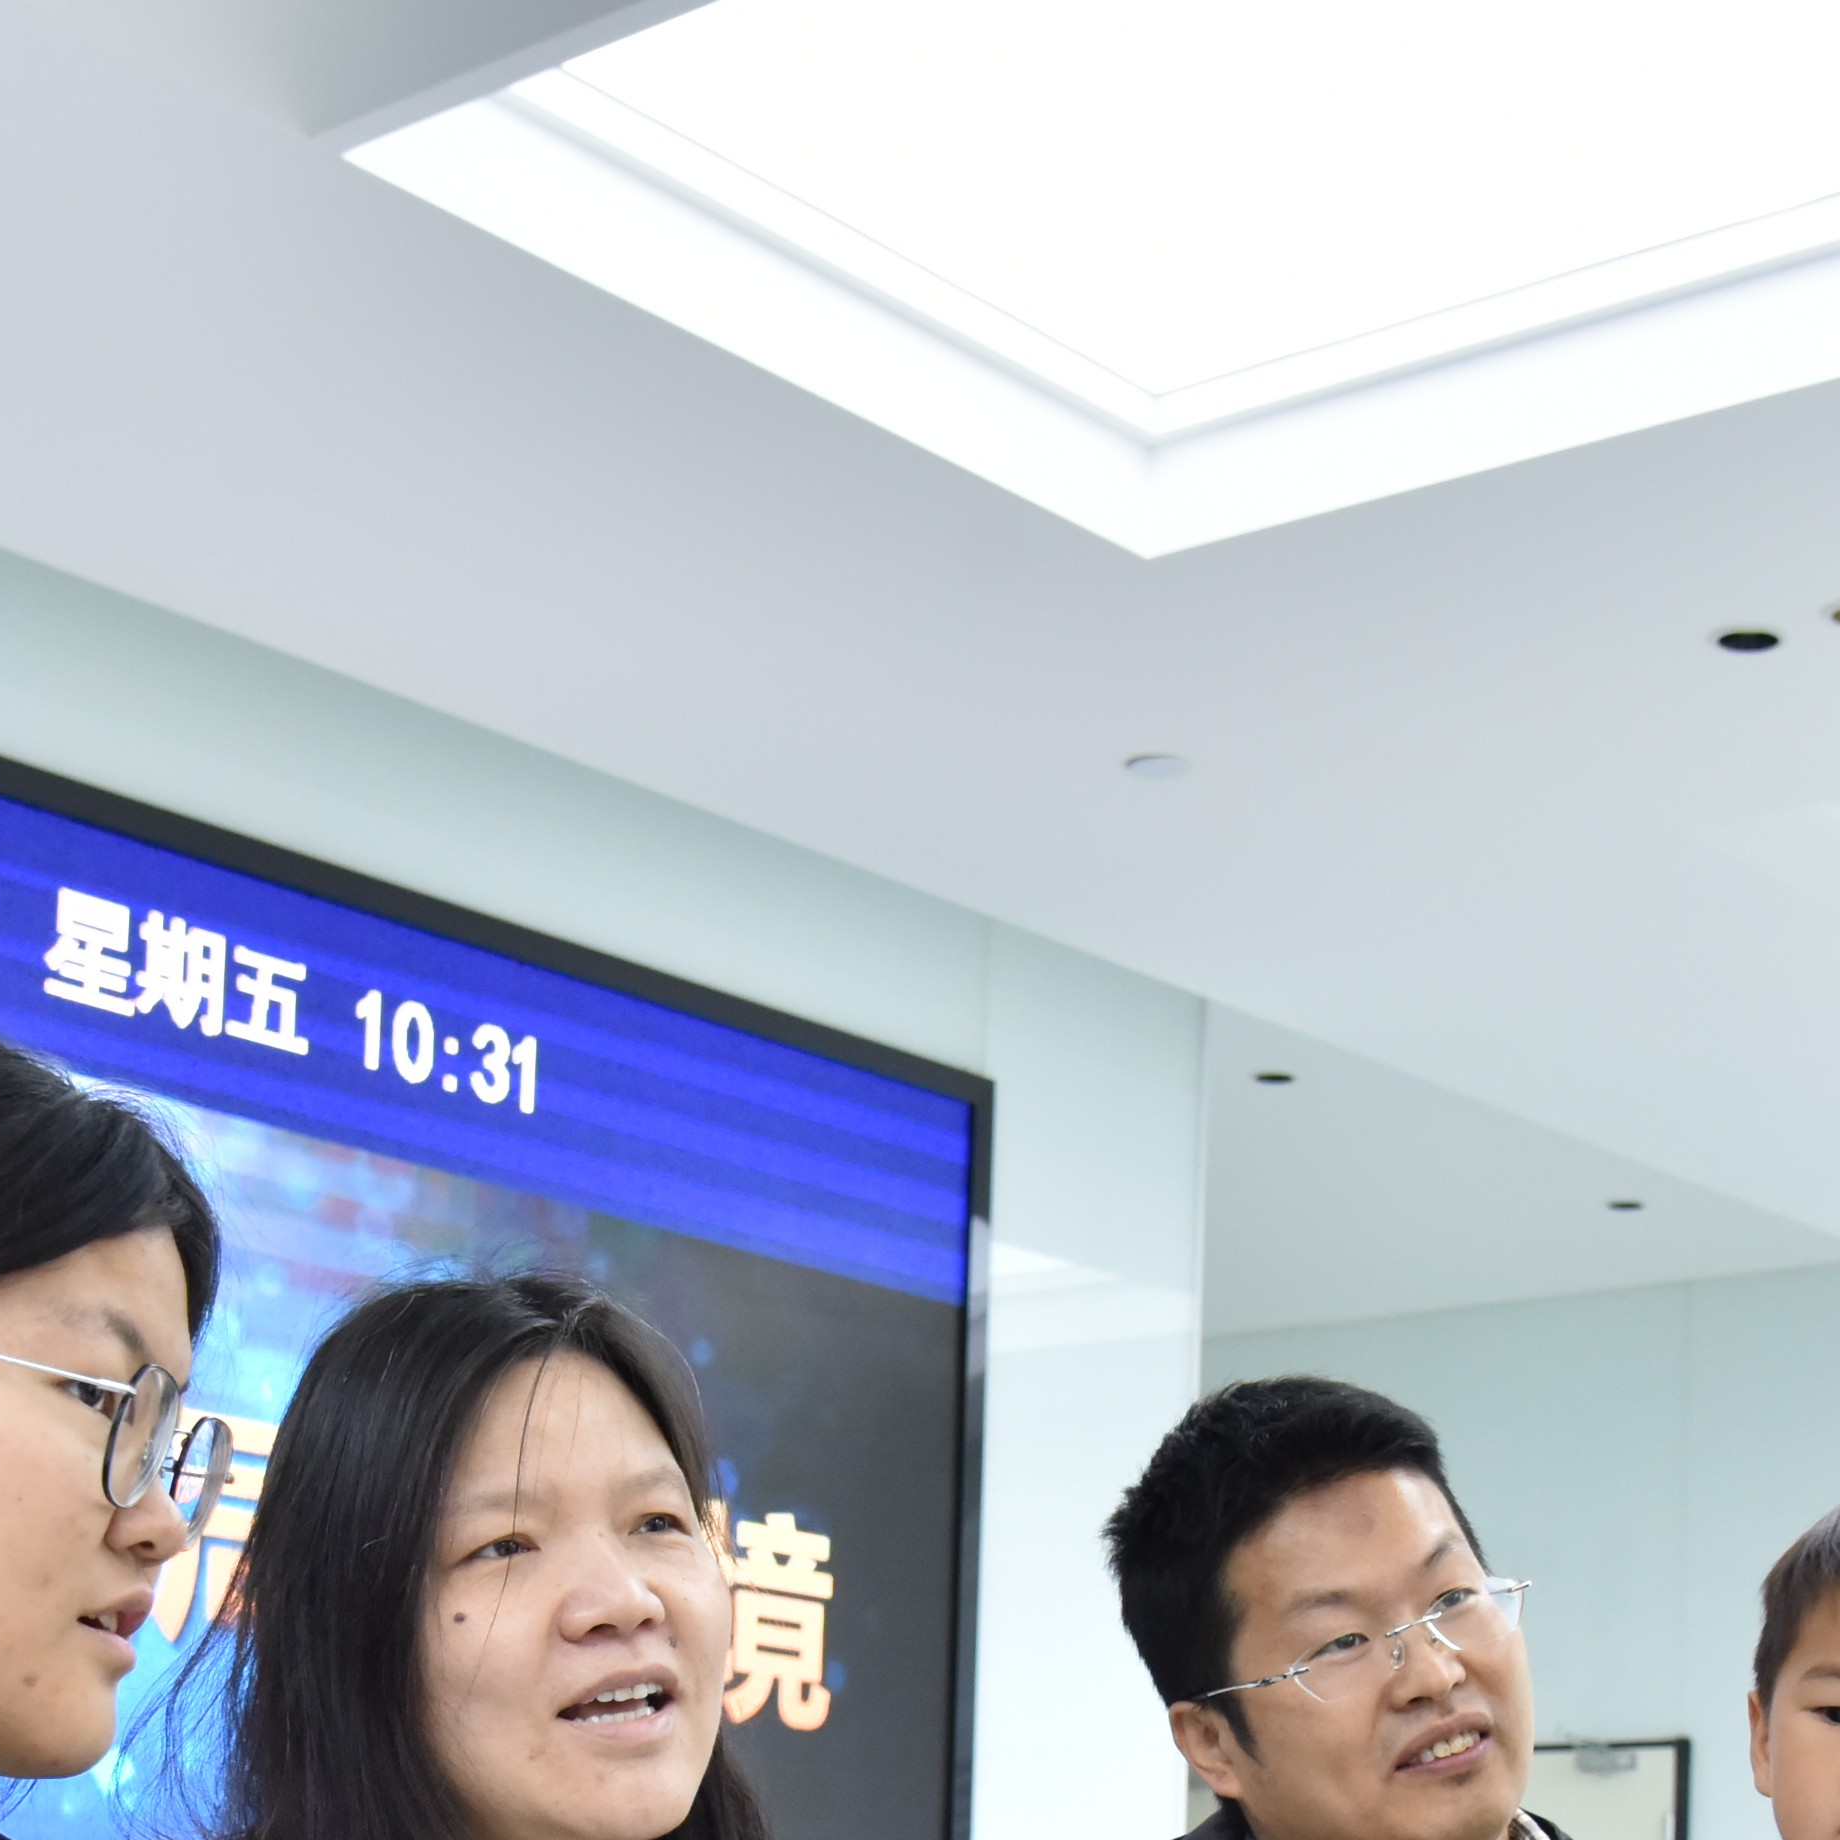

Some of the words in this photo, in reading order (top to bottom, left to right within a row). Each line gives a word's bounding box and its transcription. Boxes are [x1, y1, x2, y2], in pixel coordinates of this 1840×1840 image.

[42, 885, 310, 1055] 星期五
[355, 991, 539, 1115] 10:31
